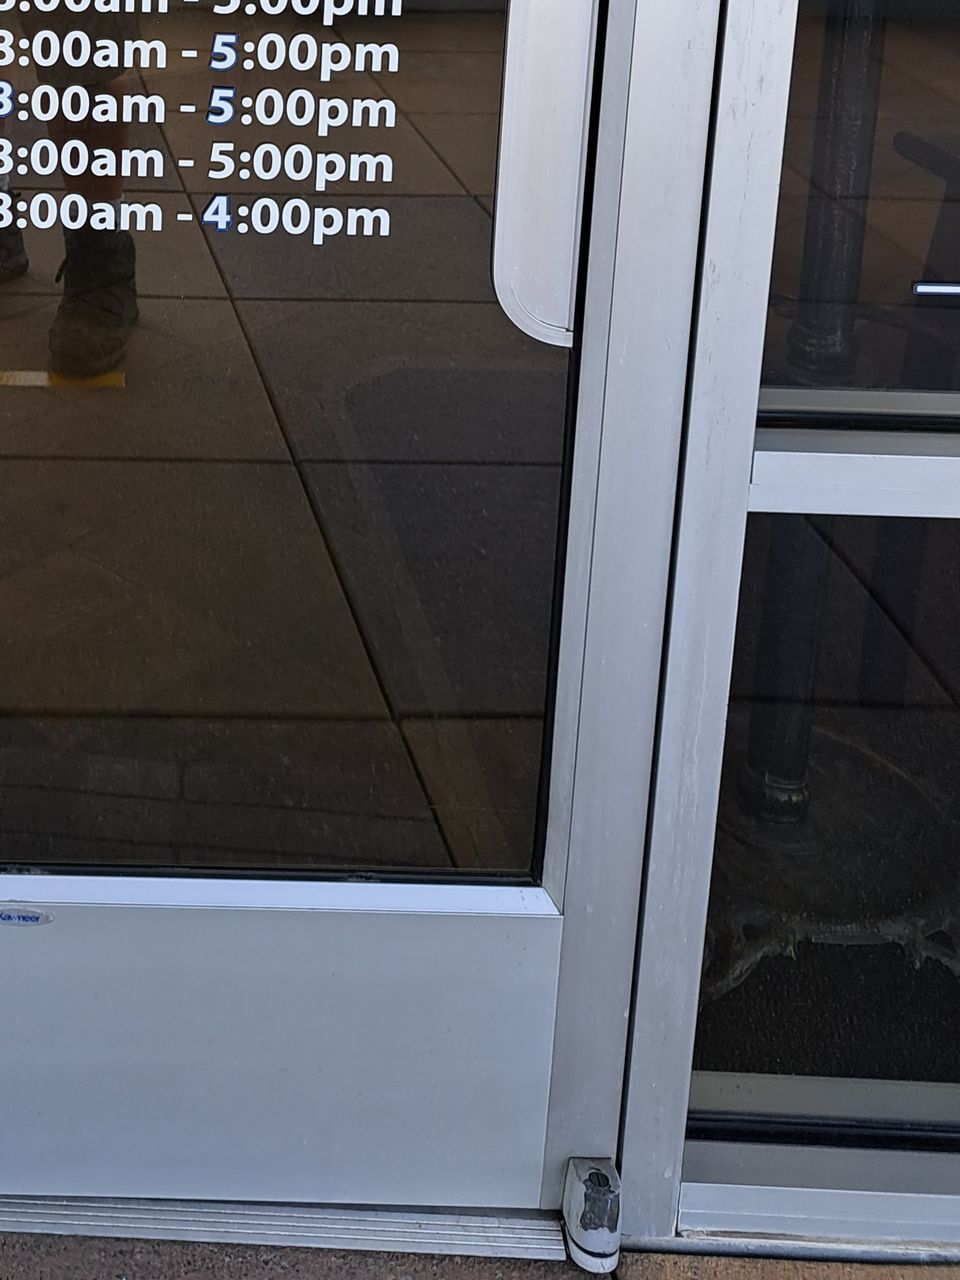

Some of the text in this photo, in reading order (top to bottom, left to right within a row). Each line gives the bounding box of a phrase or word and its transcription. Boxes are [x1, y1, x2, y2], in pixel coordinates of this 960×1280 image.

[208, 32, 400, 82] 5:00pm
[205, 85, 397, 137] 5:00pm
[208, 142, 394, 192] 5:00pm
[201, 195, 391, 245] 4:00pm
